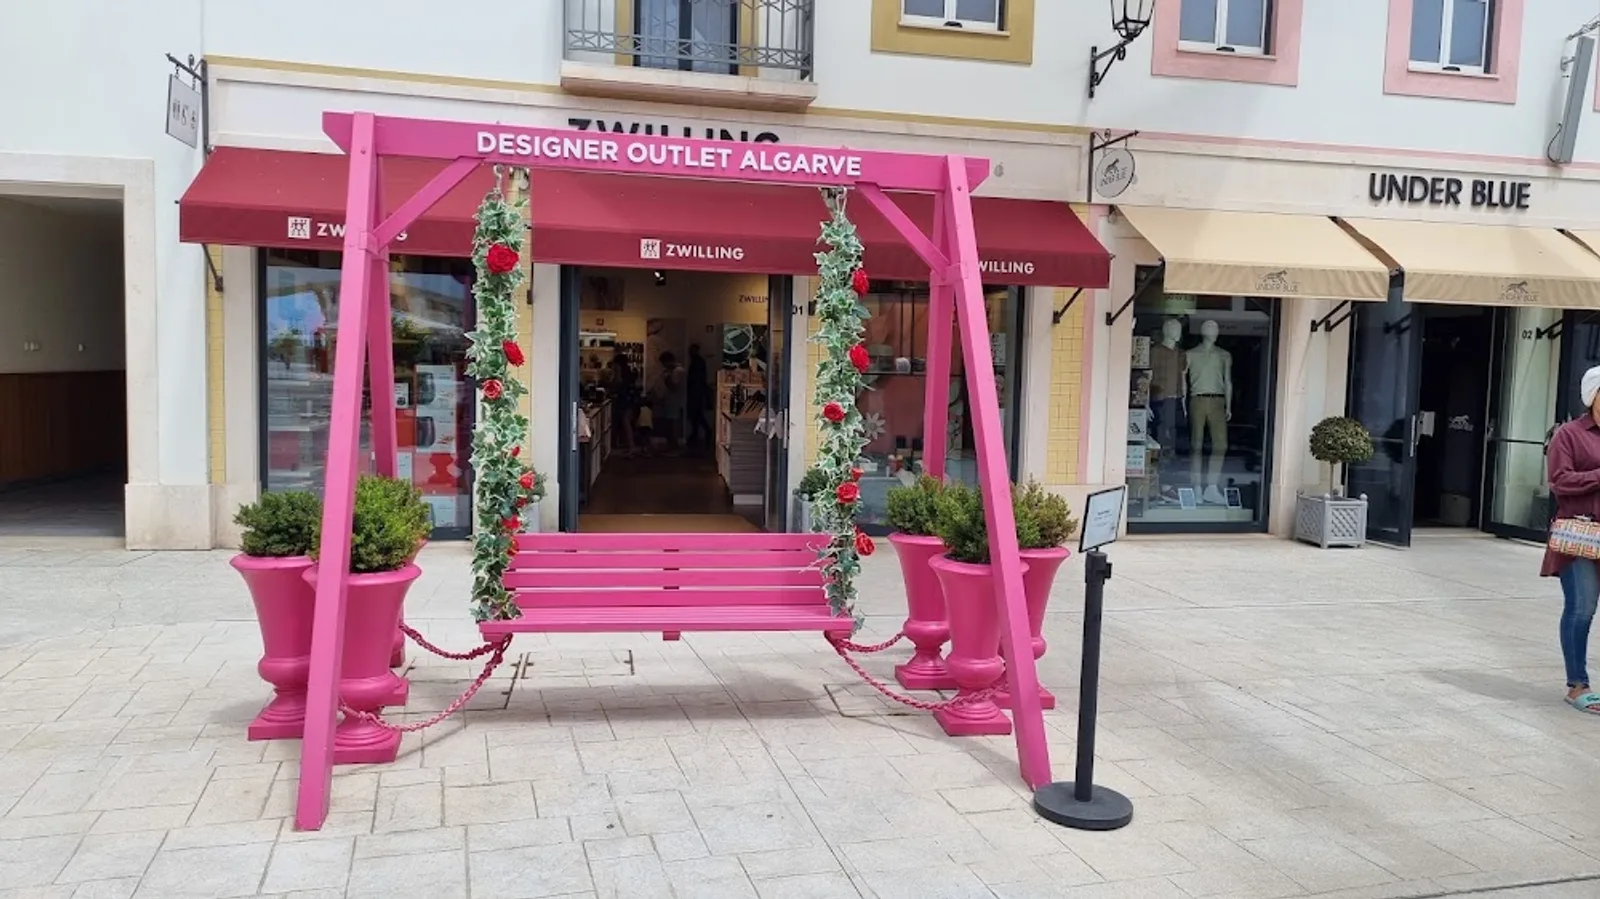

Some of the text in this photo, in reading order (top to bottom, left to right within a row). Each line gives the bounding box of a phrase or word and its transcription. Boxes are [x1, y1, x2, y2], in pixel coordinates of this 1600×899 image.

[477, 131, 619, 163] DESIGNER
[627, 142, 732, 170] OUTLET
[740, 150, 862, 176] ALGARVE
[1369, 172, 1531, 209] UNDER BLUE
[666, 244, 744, 260] ZWILLING
[978, 260, 1035, 274] WILLING
[1521, 329, 1533, 340] 02
